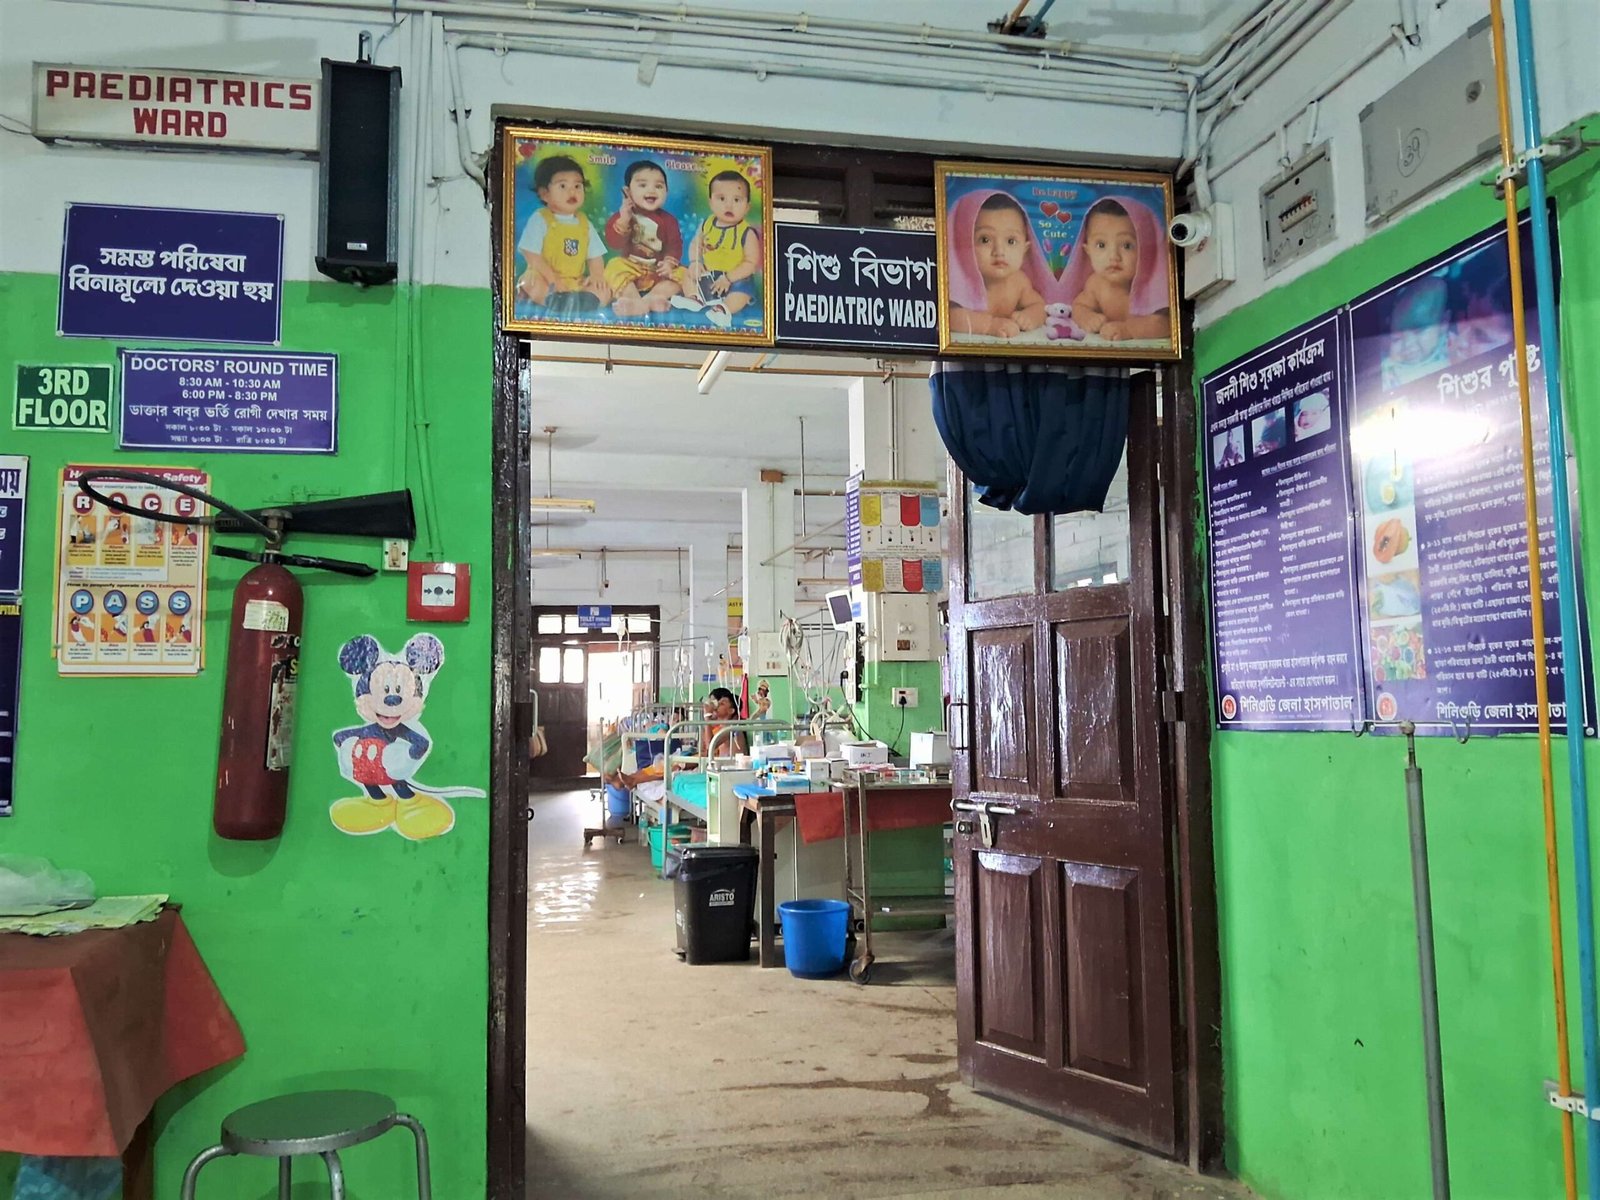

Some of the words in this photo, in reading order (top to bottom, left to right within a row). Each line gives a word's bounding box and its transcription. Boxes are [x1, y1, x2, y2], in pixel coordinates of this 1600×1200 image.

[46, 70, 312, 110] PAEDIATRICS
[133, 107, 227, 138] WARD
[588, 154, 616, 165] Smile
[1043, 230, 1067, 238] Cute
[99, 247, 155, 268] সমস্ত
[160, 244, 246, 272] পরিষেবা
[784, 242, 841, 284] শিশু
[850, 247, 936, 291] বিভাগ
[69, 264, 167, 304] বিনামূল্যে
[171, 278, 239, 300] দেওয়া
[243, 282, 274, 302] হয়
[785, 292, 884, 327] PAEDIATRIC
[889, 298, 936, 328] WARD
[224, 360, 284, 375] ROUND
[289, 363, 328, 377] TIME
[1215, 375, 1238, 405] জননী
[1238, 371, 1258, 396] শিশু
[1287, 338, 1325, 372] কার্যক্রম
[38, 368, 90, 396] 3RD
[179, 377, 202, 387] 8:30
[205, 378, 222, 388] AM
[232, 379, 260, 389] 10:30
[263, 379, 281, 389] AM
[1437, 364, 1492, 403] শিশুর
[182, 390, 205, 399] 6:00
[208, 390, 225, 400] PM
[235, 391, 258, 400] 8:30
[260, 391, 278, 401] PM
[19, 398, 106, 426] FLOOR
[129, 405, 168, 417] ডাক্তার
[173, 406, 200, 421] বাবুর
[204, 404, 230, 418] ভর্তি
[234, 405, 262, 419] রোগী
[266, 408, 298, 420] দেখার
[303, 410, 327, 421] সময়
[76, 496, 90, 509] R
[144, 498, 158, 510] C
[180, 499, 191, 511] E
[76, 596, 89, 608] P
[107, 595, 123, 607] A
[141, 596, 153, 609] S
[173, 596, 186, 609] S
[1278, 696, 1302, 713] জেলা
[1304, 696, 1353, 714] হাসপাতাল
[1484, 702, 1512, 718] জেলা
[710, 893, 734, 901] ARISTO
